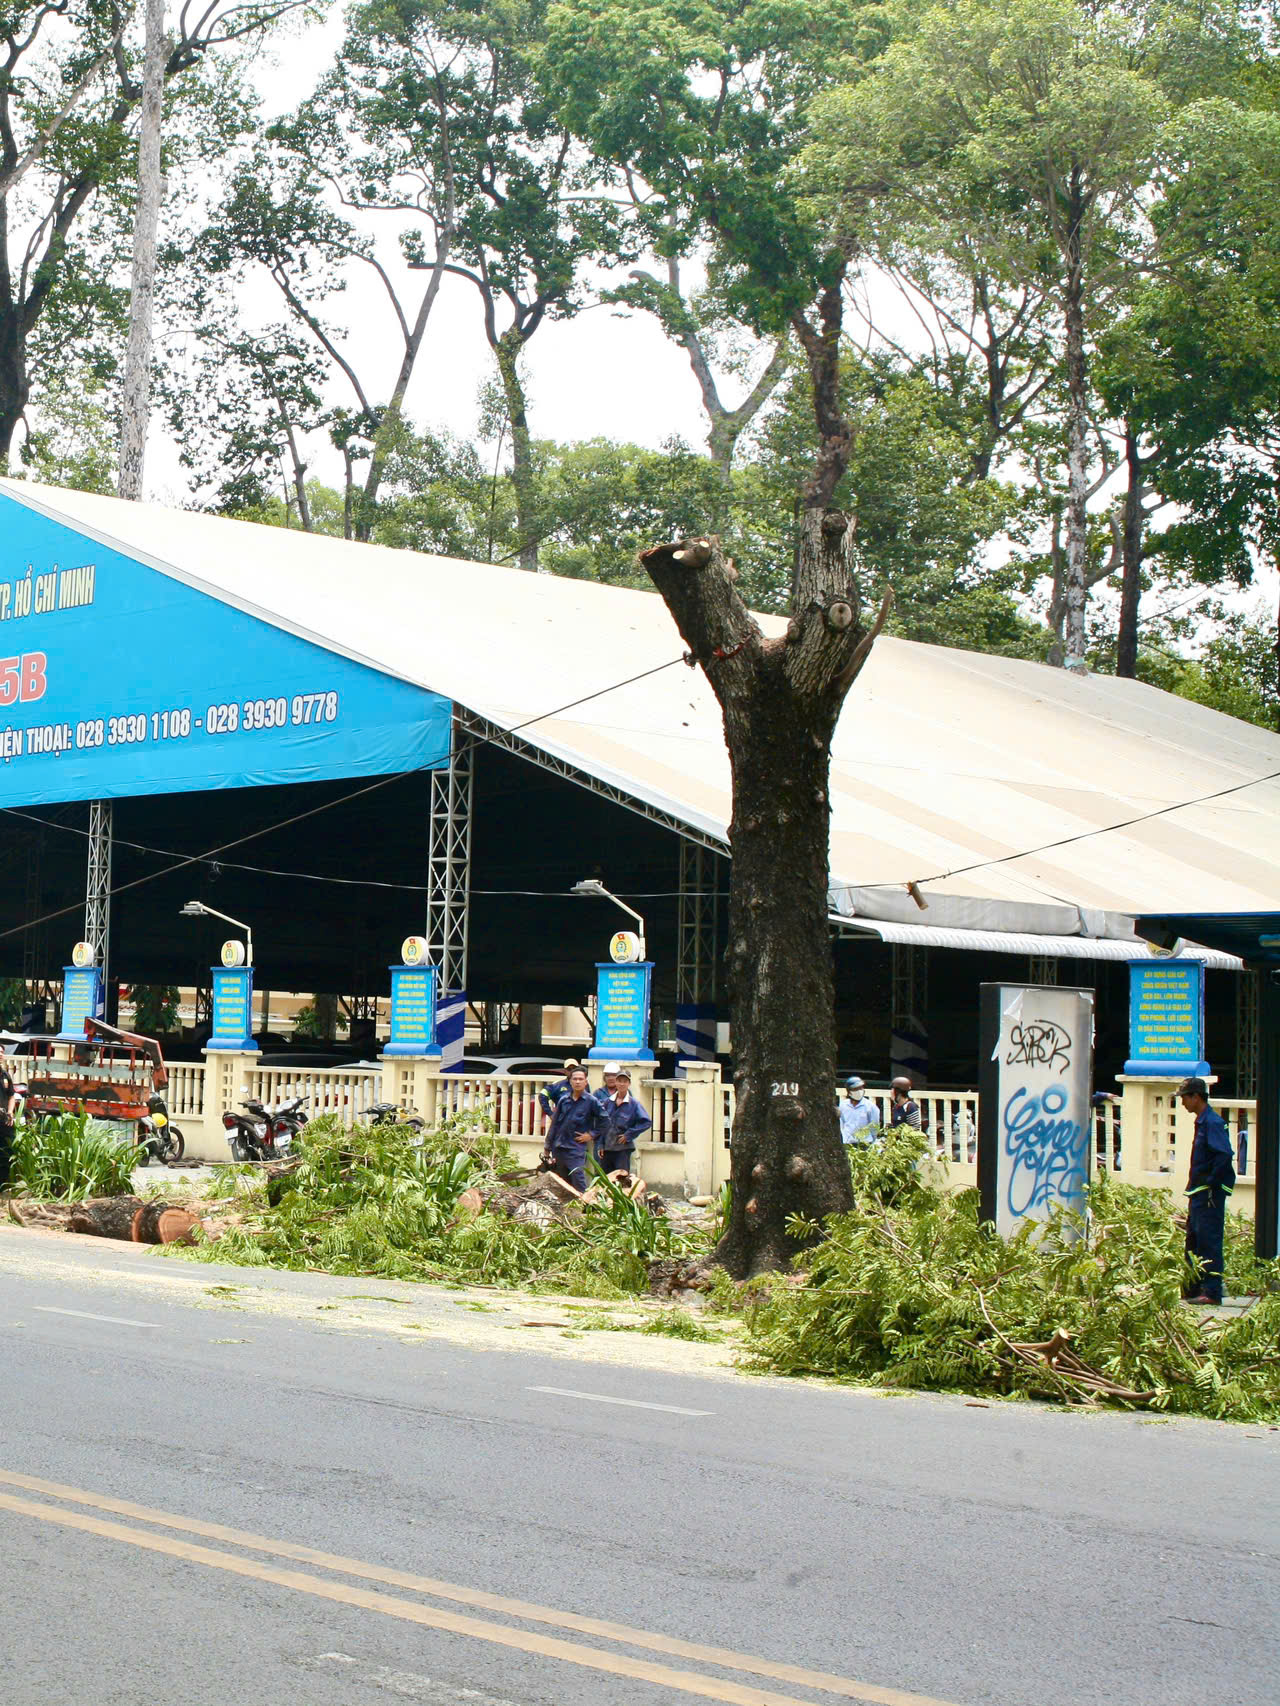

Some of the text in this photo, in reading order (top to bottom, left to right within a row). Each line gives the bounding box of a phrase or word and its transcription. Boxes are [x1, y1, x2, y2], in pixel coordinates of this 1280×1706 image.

[14, 564, 33, 618] HỒ
[34, 563, 59, 615] CHÍ
[59, 564, 96, 610] MINH
[26, 723, 72, 757] THOẠI:
[76, 719, 105, 749] 028
[107, 713, 147, 745] 3930
[150, 708, 192, 741] 1108
[206, 703, 239, 735] 028
[242, 697, 287, 731] 3930
[291, 691, 339, 726] 9778
